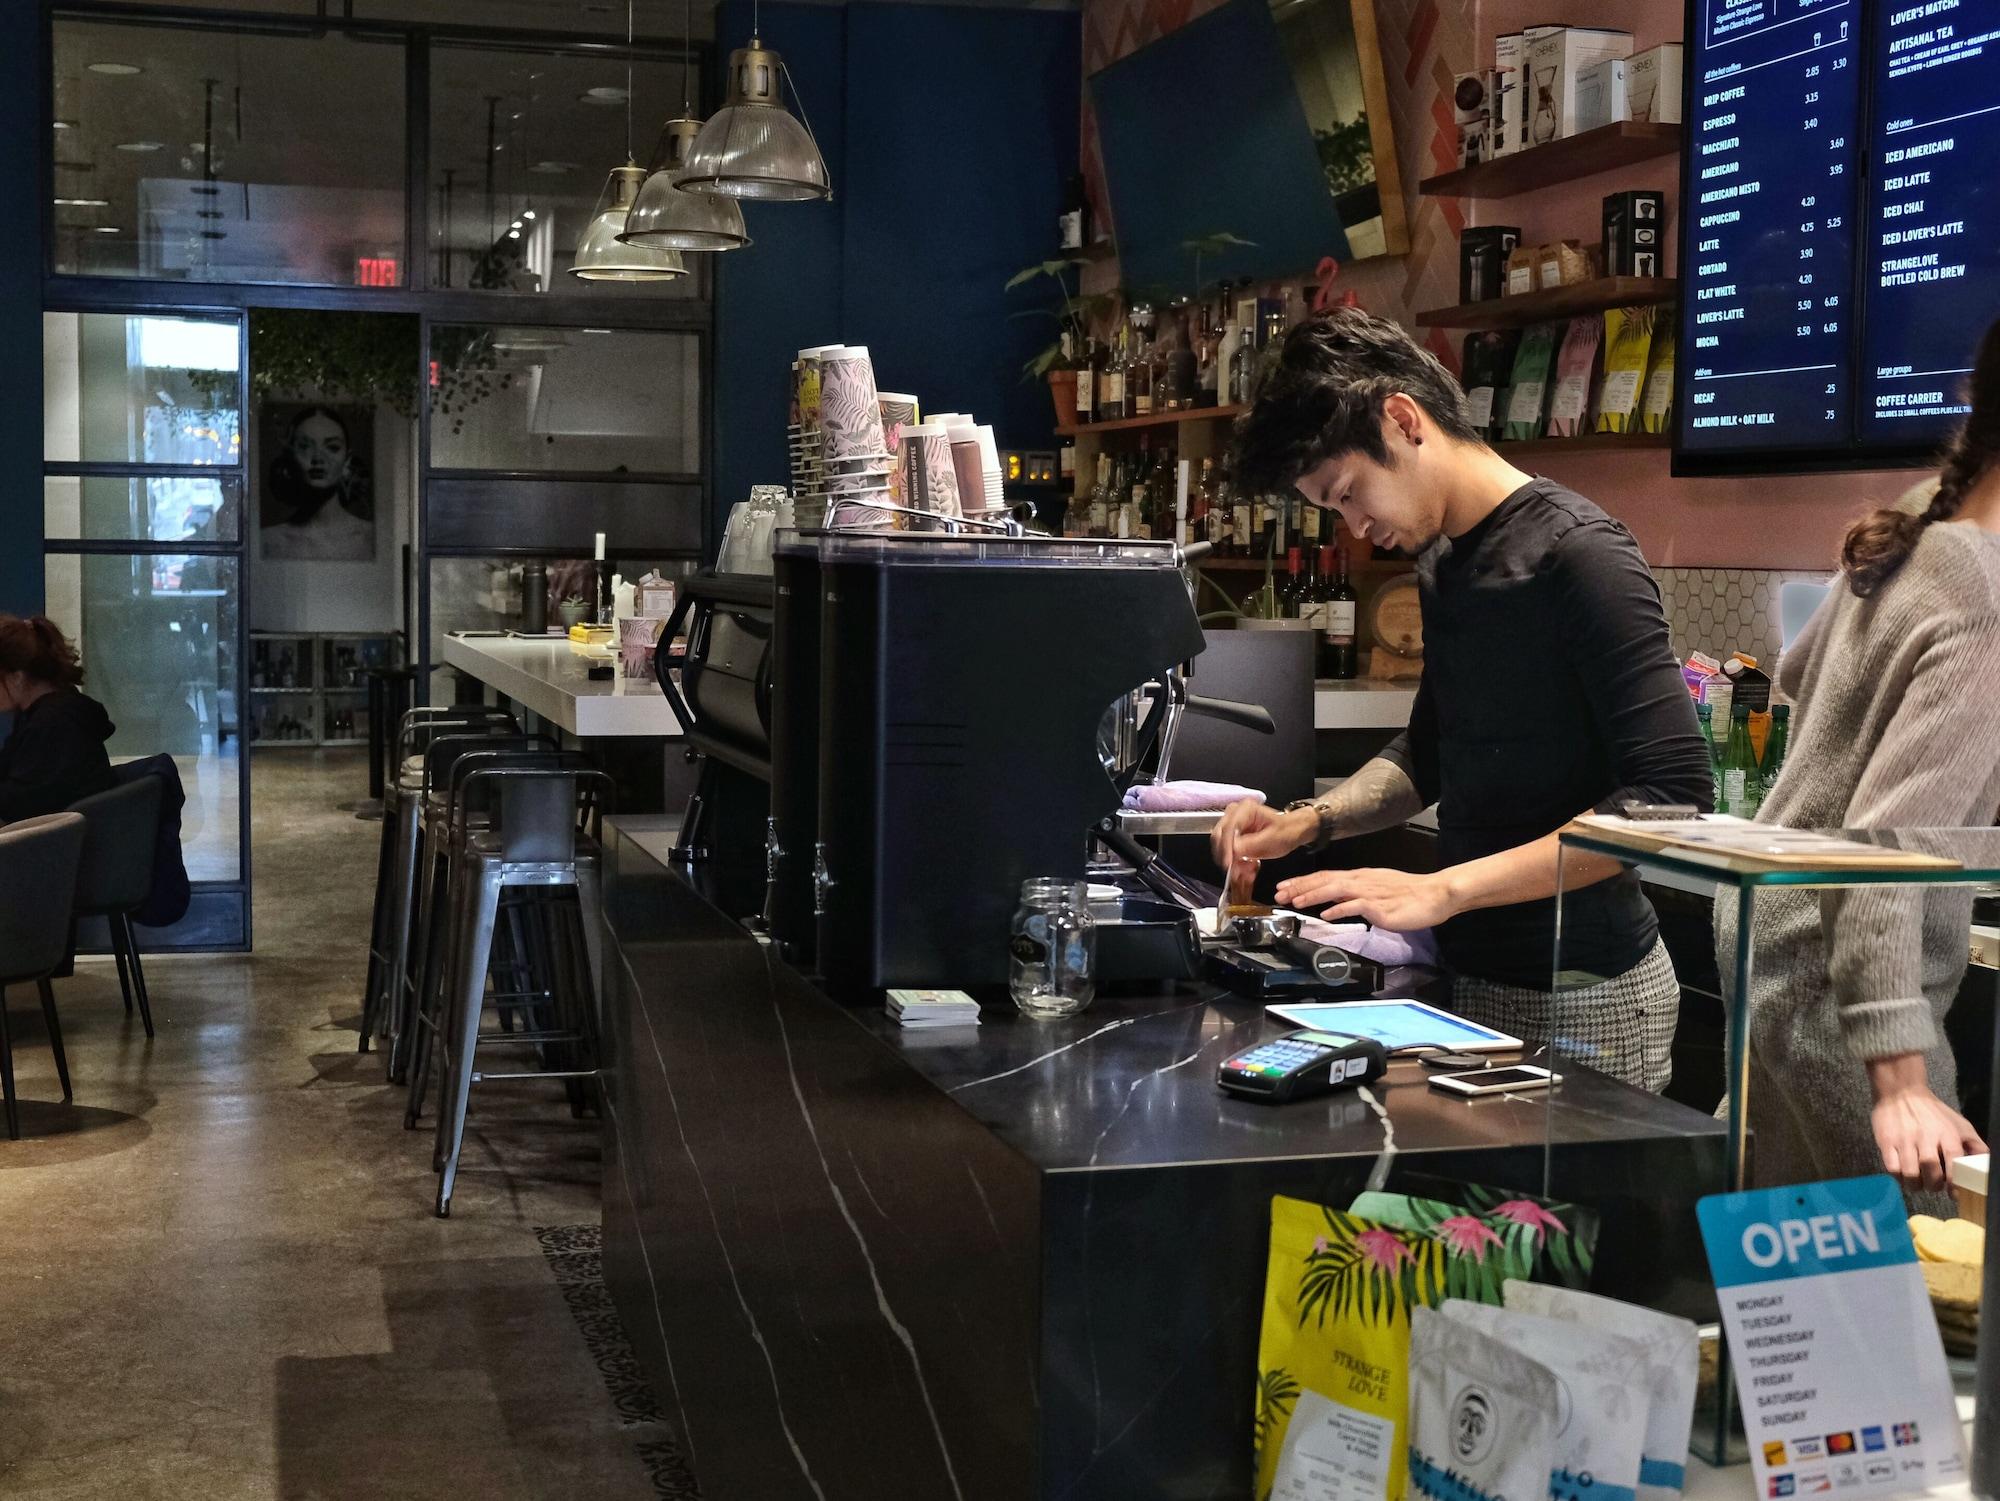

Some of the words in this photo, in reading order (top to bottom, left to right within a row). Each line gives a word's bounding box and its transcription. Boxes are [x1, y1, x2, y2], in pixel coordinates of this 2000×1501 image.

[1891, 6, 1924, 26] LOVER'S
[1925, 0, 1960, 16] MATCHA
[1889, 31, 1935, 54] ARTISANAL
[1936, 25, 1953, 40] TEA
[1901, 56, 1910, 64] TEA
[1914, 50, 1930, 60] CREAM
[1950, 41, 1964, 50] GREY
[1967, 33, 1988, 46] ORGANIC
[1630, 58, 1654, 74] CHEMEX
[1832, 58, 1847, 70] 3.30
[1926, 58, 1943, 68] LEMON
[1805, 66, 1819, 78] 2.85
[1704, 93, 1719, 107] DRIP
[1720, 86, 1745, 102] COFFEE
[1805, 92, 1818, 104] 3.15
[1703, 113, 1736, 131] ESPRESSO
[1804, 118, 1818, 130] 3.40
[1886, 120, 1899, 131] Cold
[1900, 118, 1913, 128] ones
[1702, 137, 1739, 156] MACCHIATO
[1830, 138, 1844, 150] 3.60
[1885, 147, 1904, 164] ICED
[1906, 138, 1954, 160] AMERICANO
[1701, 162, 1739, 180] AMERICANO
[1829, 164, 1843, 176] 3.95
[1884, 176, 1902, 192] ICED
[1904, 171, 1930, 188] LATTE
[1700, 185, 1737, 204] AMERICANO
[1739, 182, 1760, 197] MISTO
[1801, 196, 1815, 207] 4.20
[1883, 203, 1902, 218] ICED
[1903, 200, 1924, 215] CHAI
[1700, 211, 1740, 229] CAPPUCCINO
[1801, 222, 1814, 233] 4.75
[1827, 217, 1841, 229] 5.25
[1882, 232, 1901, 246] ICED
[1902, 226, 1936, 243] LOVER'S
[1937, 221, 1964, 238] LATTE
[1699, 239, 1719, 251] LATTE
[1800, 248, 1814, 259] 3.90
[1699, 262, 1727, 276] CORTADO
[1882, 254, 1938, 273] STRANGELOVE
[1799, 274, 1812, 285] 4.20
[1881, 271, 1916, 287] BOTTLED
[1918, 268, 1939, 283] COLD
[1940, 264, 1965, 281] BREW
[1698, 288, 1713, 300] FLAT
[1714, 285, 1736, 298] WHITE
[1798, 300, 1811, 310] 5.50
[1824, 296, 1838, 307] 6.05
[1697, 311, 1723, 324] LOVER'S
[1723, 308, 1744, 321] LATTE
[1797, 325, 1810, 336] 5.50
[1823, 322, 1837, 334] 6.05
[1696, 336, 1719, 348] MOCHA
[1877, 367, 1892, 376] Large
[1893, 366, 1912, 375] groups
[1694, 393, 1715, 404] DECAF
[1876, 394, 1906, 407] COFFEE
[1908, 392, 1943, 405] CARRIER
[1693, 416, 1720, 428] ALMOND
[1720, 415, 1738, 426] MILK
[1743, 414, 1756, 425] OAT
[1757, 413, 1775, 424] MILK
[1875, 410, 1897, 418] INCLUDES
[1904, 409, 1919, 417] SMALL
[1920, 408, 1940, 416] COFFEES
[1741, 1209, 1880, 1268] OPEN
[1736, 1295, 1783, 1311] MONDAY
[1741, 1314, 1792, 1330] TUESDAY
[1745, 1330, 1815, 1349] WEDNESDAY
[1750, 1350, 1809, 1368] THURSDAY
[1332, 1350, 1392, 1385] STRANGE
[1752, 1372, 1793, 1387] FRIDAY
[1348, 1375, 1388, 1401] LOVE
[1758, 1389, 1817, 1407] SATURDAY
[1761, 1410, 1806, 1427] SUNDAY
[1798, 1443, 1820, 1455] VISA
